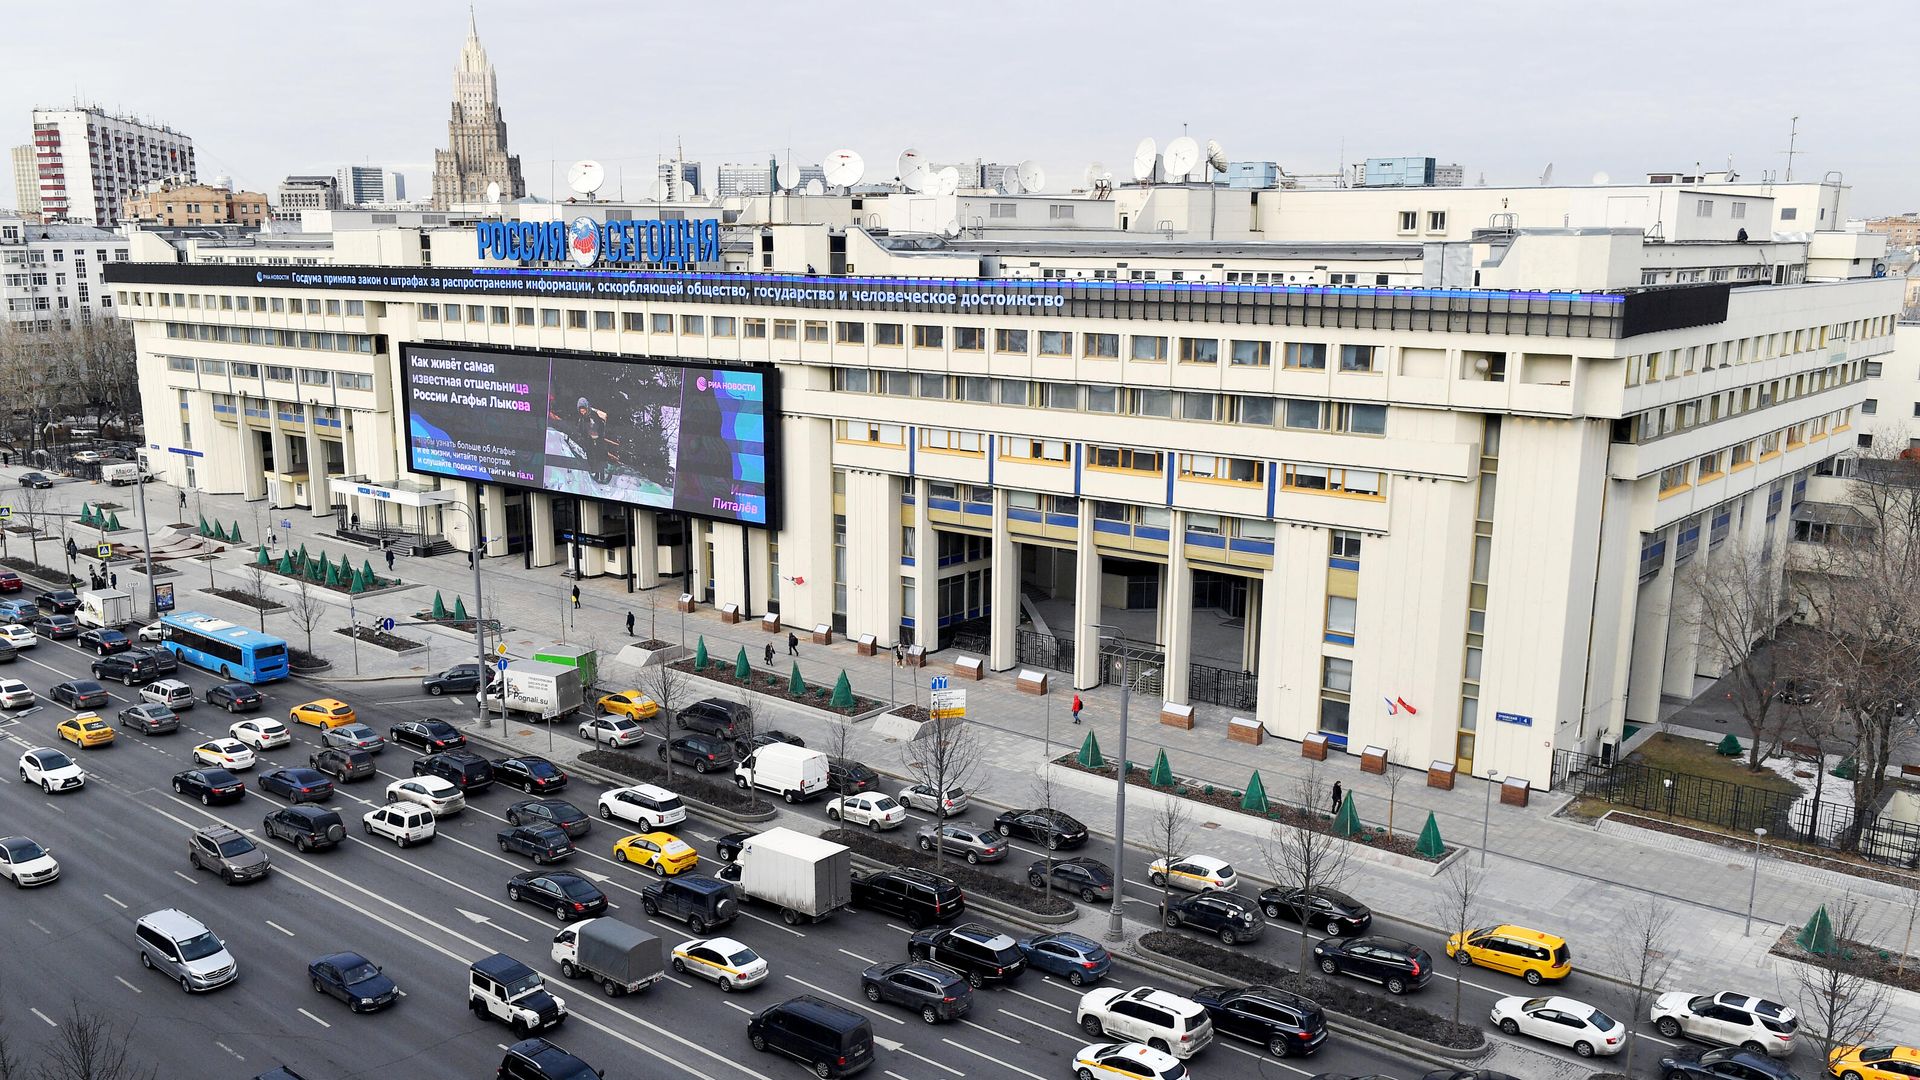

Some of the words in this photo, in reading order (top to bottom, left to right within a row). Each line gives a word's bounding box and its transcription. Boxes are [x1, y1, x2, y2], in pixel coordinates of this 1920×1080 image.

[476, 220, 567, 261] РОССИЯ
[604, 218, 720, 270] СЕГОДНЯ
[291, 272, 322, 285] Госдума
[324, 275, 356, 285] приняла
[358, 276, 381, 285] закон
[383, 276, 389, 285] о
[390, 275, 428, 288] штрафах
[430, 278, 440, 287] за
[442, 278, 523, 290] распространение
[526, 277, 595, 294] информации,
[598, 280, 684, 296] оскорбляющей
[687, 282, 750, 300] общество,
[754, 287, 835, 301] государство
[839, 288, 848, 301] и
[852, 290, 957, 305] человеческое
[960, 292, 1065, 308] достоинство
[411, 355, 429, 368] Как
[430, 358, 461, 371] живёт
[463, 361, 495, 373] самая
[412, 374, 461, 388] известная
[463, 378, 529, 395] отшельница
[708, 381, 721, 389] РИА
[722, 382, 756, 392] НОВОСТИ
[413, 388, 448, 403] России
[450, 392, 487, 408] Агафья
[489, 395, 531, 412] Лыкова
[457, 440, 481, 451] больше
[482, 444, 491, 453] об
[491, 445, 516, 457] Агафье
[453, 451, 477, 462] читайте
[478, 455, 511, 467] репортаж
[423, 458, 451, 468] слушайте
[453, 462, 478, 472] подкаст
[488, 467, 506, 476] тайги
[517, 470, 534, 480] ria.ru
[712, 497, 758, 514] Питалёв
[513, 691, 549, 705] Pognali.su
